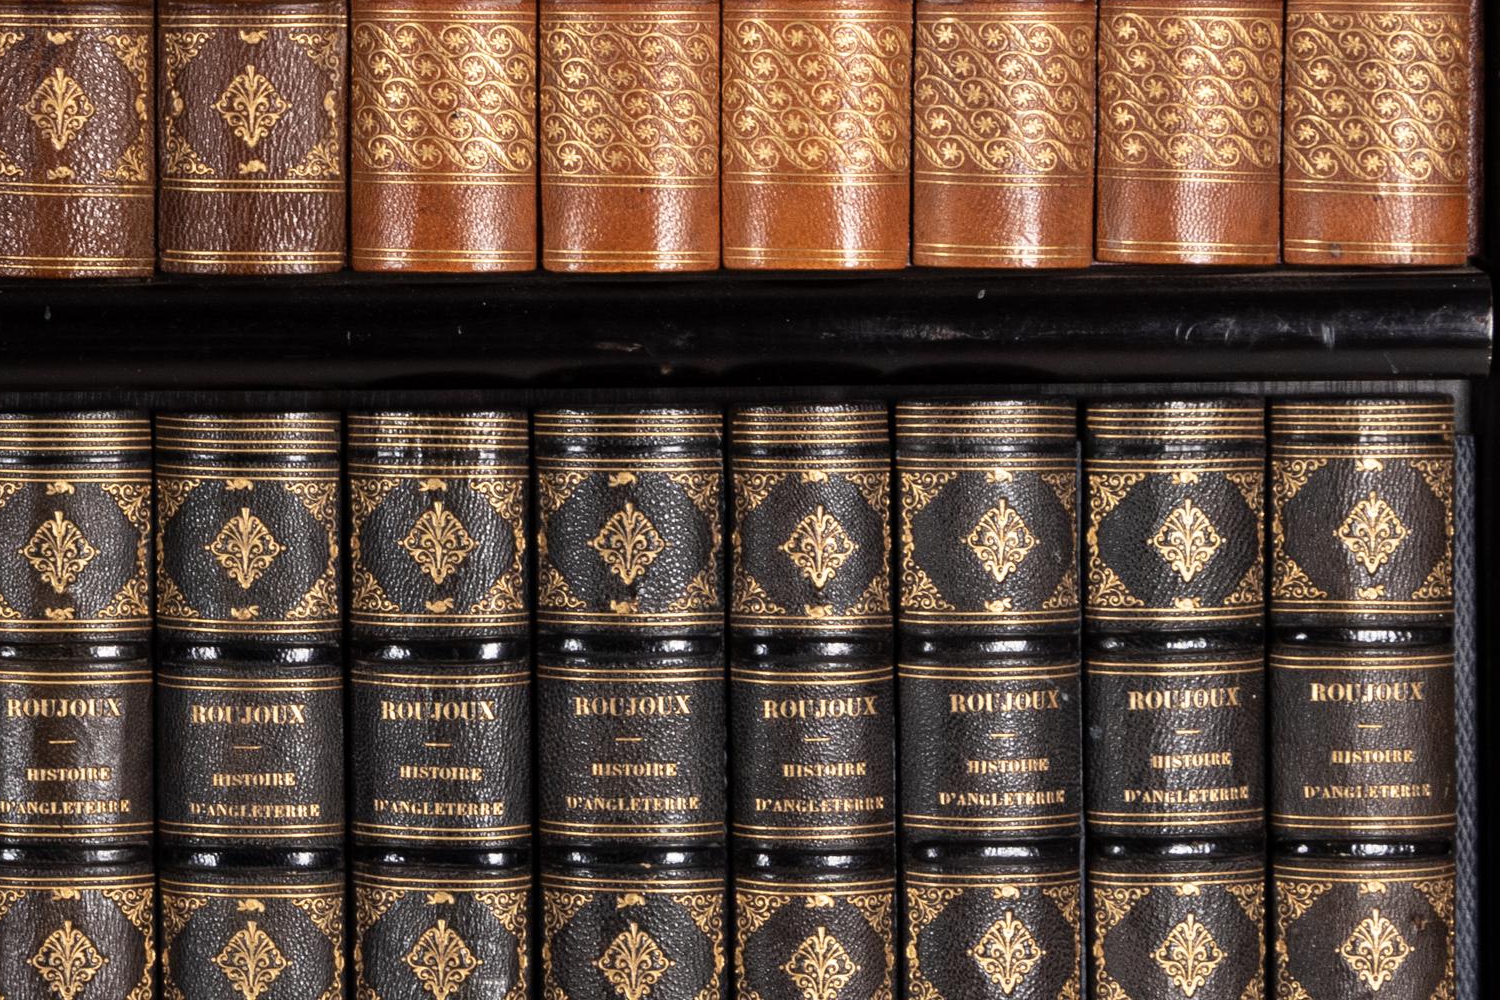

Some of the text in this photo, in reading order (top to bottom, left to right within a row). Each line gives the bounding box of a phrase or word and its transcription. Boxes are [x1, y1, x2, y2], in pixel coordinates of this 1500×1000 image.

[950, 688, 1058, 712] ROUJOUX
[1128, 688, 1238, 712] ROUJOUX
[1311, 681, 1423, 703] ROUJOUX
[7, 696, 121, 721] ROUJOUX
[192, 702, 306, 726] ROUJOUX
[381, 699, 495, 722] ROUJOUX
[573, 694, 691, 719] ROUJOUX
[762, 695, 877, 719] ROUJOUX
[967, 757, 1049, 775] HISTOIRE
[1151, 750, 1231, 768] HISTOIRE
[1332, 748, 1413, 766] HISTOIRE
[26, 766, 111, 784] HISTOIRE
[400, 765, 482, 782] HISTOIRE
[592, 761, 676, 779] HISTOIRE
[783, 761, 866, 778] HISTOIRE
[213, 771, 294, 789] HISTOIRE
[939, 788, 1065, 807] D'ANGLETERRE
[1124, 784, 1248, 804] D'ANGLETERRE
[1304, 782, 1432, 800] D'ANGLETERRE
[0, 799, 130, 818] D'ANGLETERRE
[190, 800, 320, 819] D'ANGLETERRE
[374, 798, 504, 818] D'ANGLETERRE
[566, 794, 698, 814] D'ANGLETERRE
[756, 794, 884, 814] D'ANGLETERRE
